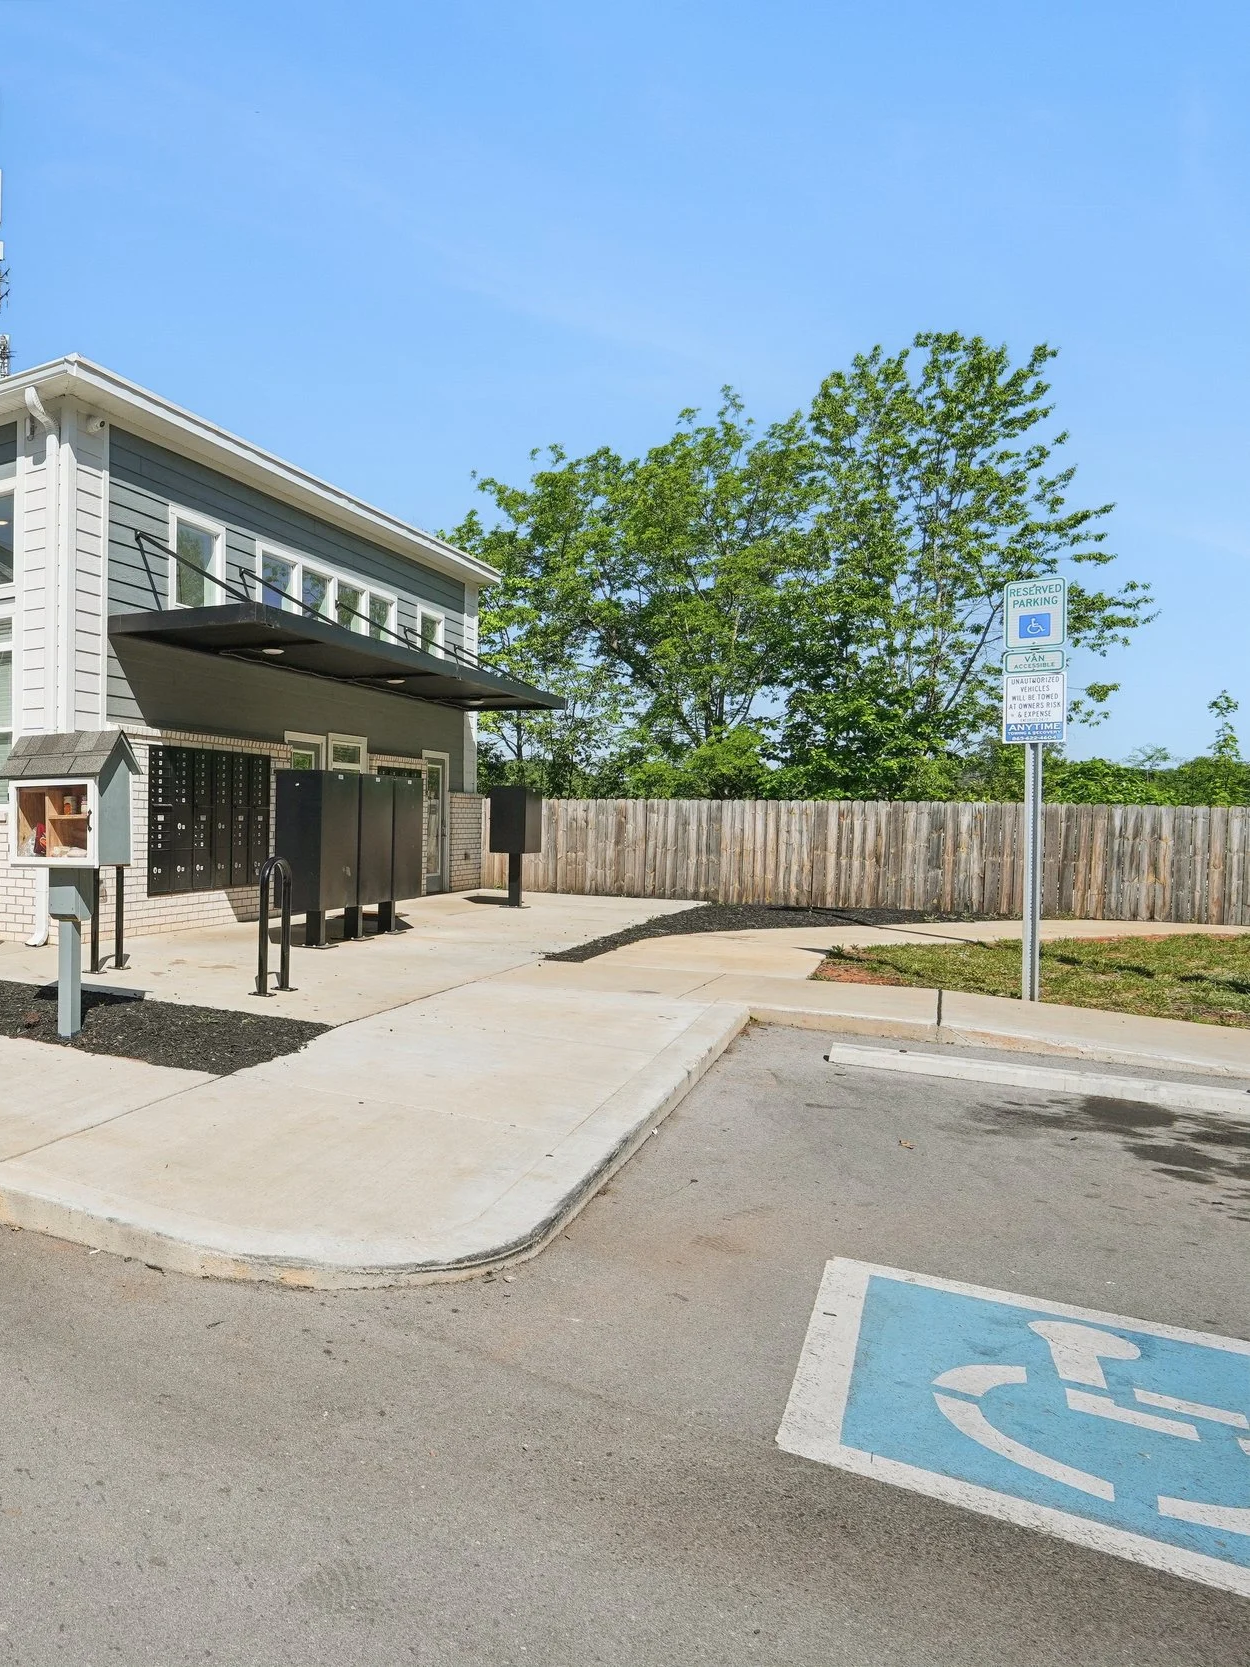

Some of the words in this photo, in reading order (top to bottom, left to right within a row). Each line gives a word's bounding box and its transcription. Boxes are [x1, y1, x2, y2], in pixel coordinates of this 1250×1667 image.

[1010, 584, 1061, 597] RESERVED
[1013, 596, 1058, 608] PARKING
[1011, 676, 1059, 685] UNAUTHORIZED
[1009, 723, 1061, 731] ANYTIME
